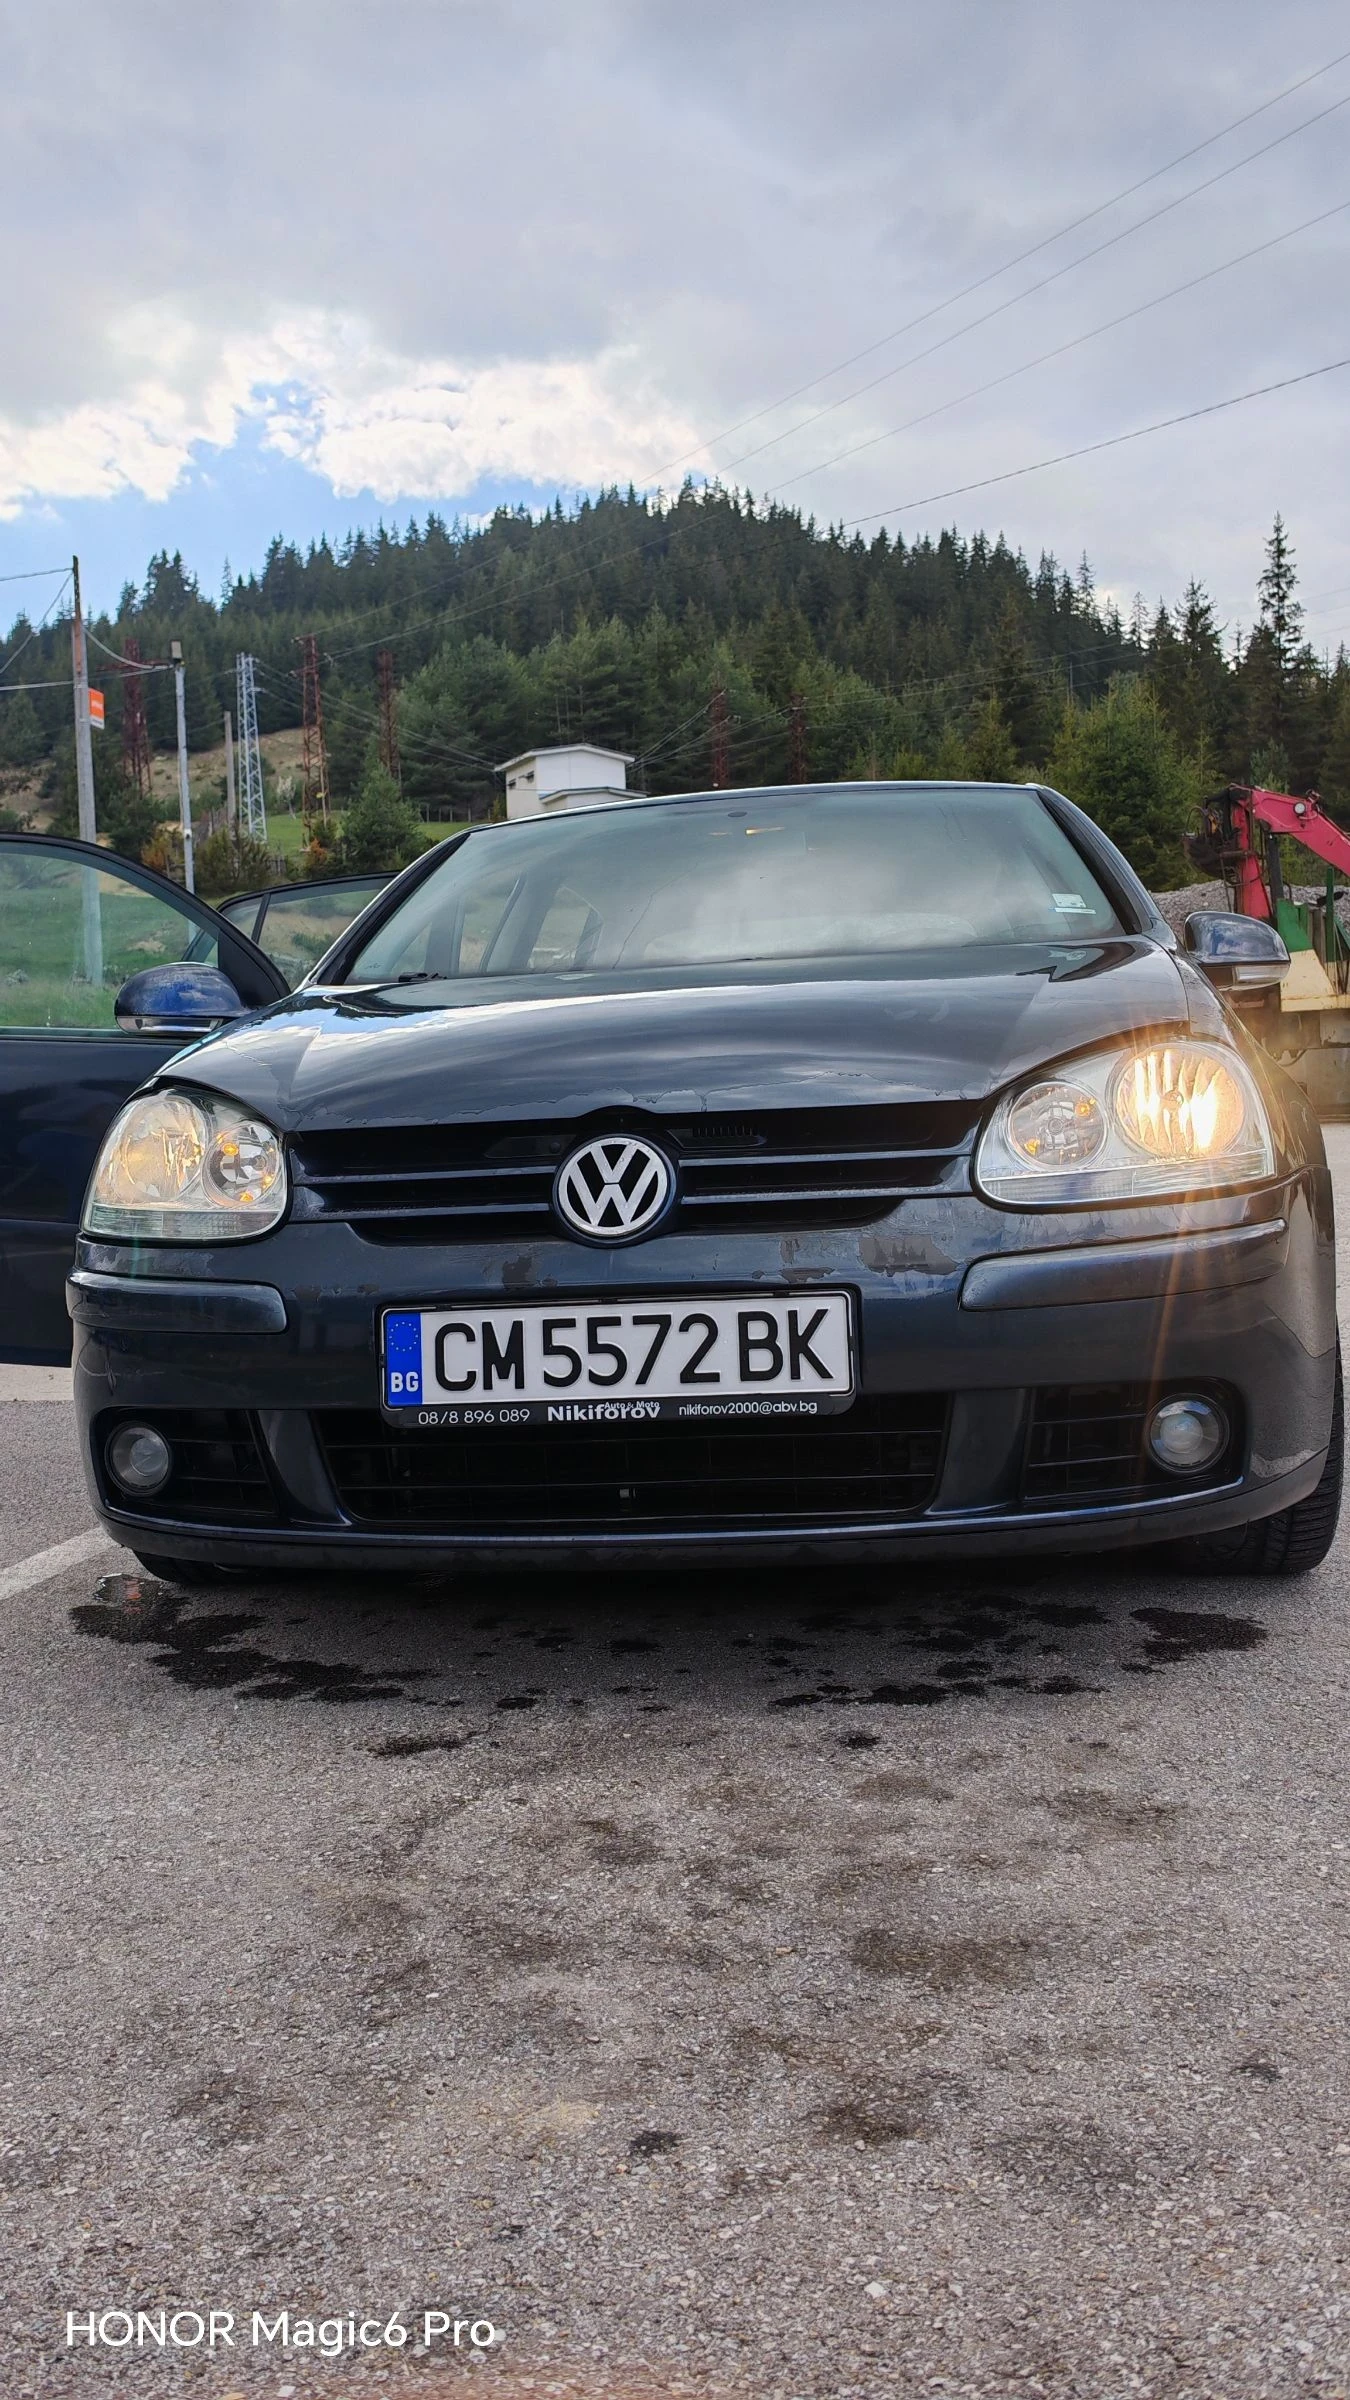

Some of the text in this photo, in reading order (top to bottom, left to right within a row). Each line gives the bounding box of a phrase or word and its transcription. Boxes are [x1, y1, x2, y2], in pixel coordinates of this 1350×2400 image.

[558, 1138, 667, 1235] VW
[435, 1308, 834, 1391] CM 5572 BK
[390, 1371, 419, 1393] BG
[547, 1404, 661, 1422] Nikiforov
[604, 1402, 625, 1410] Auto
[636, 1400, 660, 1408] Moto
[679, 1401, 818, 1416] nikiforov2000@abv.bg
[464, 1410, 495, 1424] 896
[499, 1408, 531, 1423] 089
